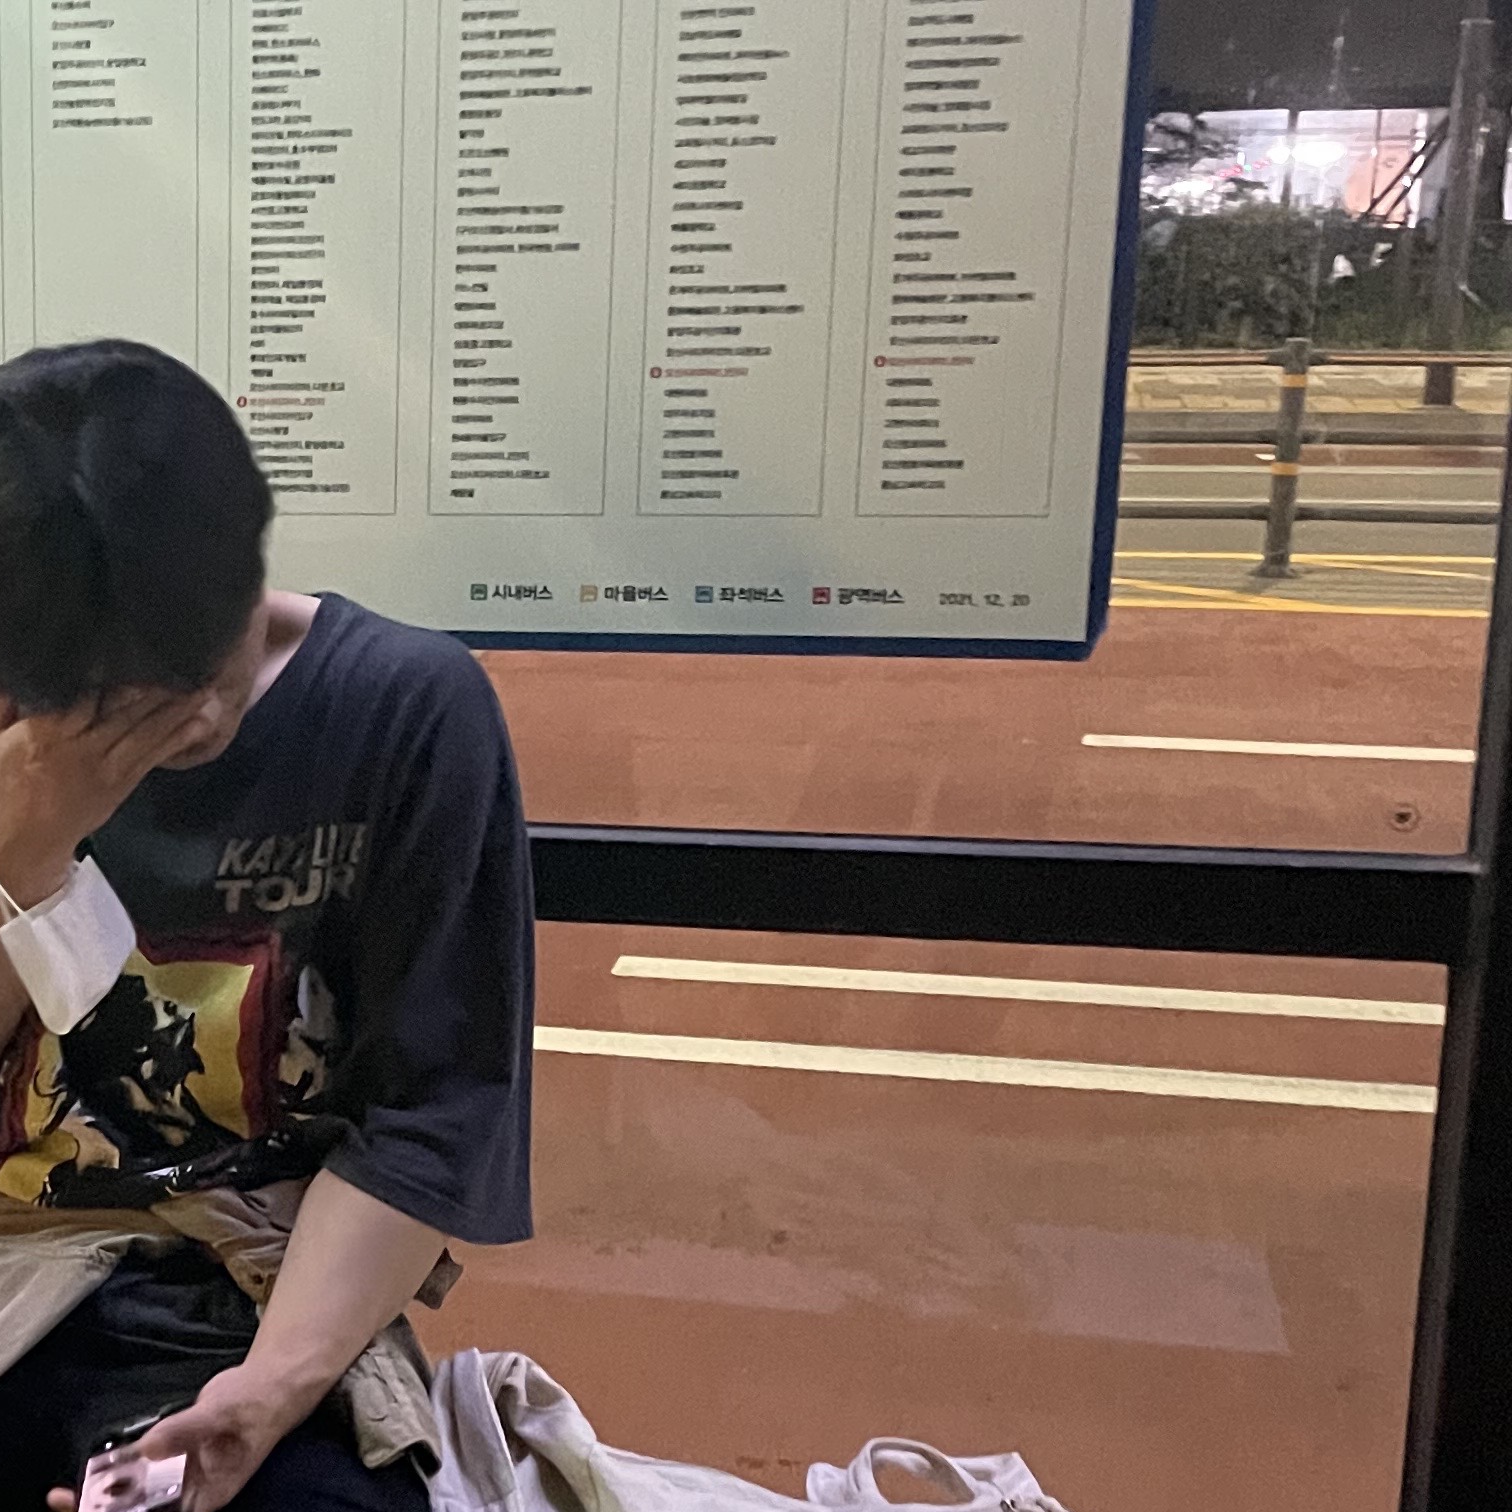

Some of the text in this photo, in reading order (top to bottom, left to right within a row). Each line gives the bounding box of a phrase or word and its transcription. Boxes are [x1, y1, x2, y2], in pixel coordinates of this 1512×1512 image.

[491, 584, 553, 600] 시내버스
[603, 585, 669, 602] 마을버스
[719, 587, 785, 603] 좌석버스
